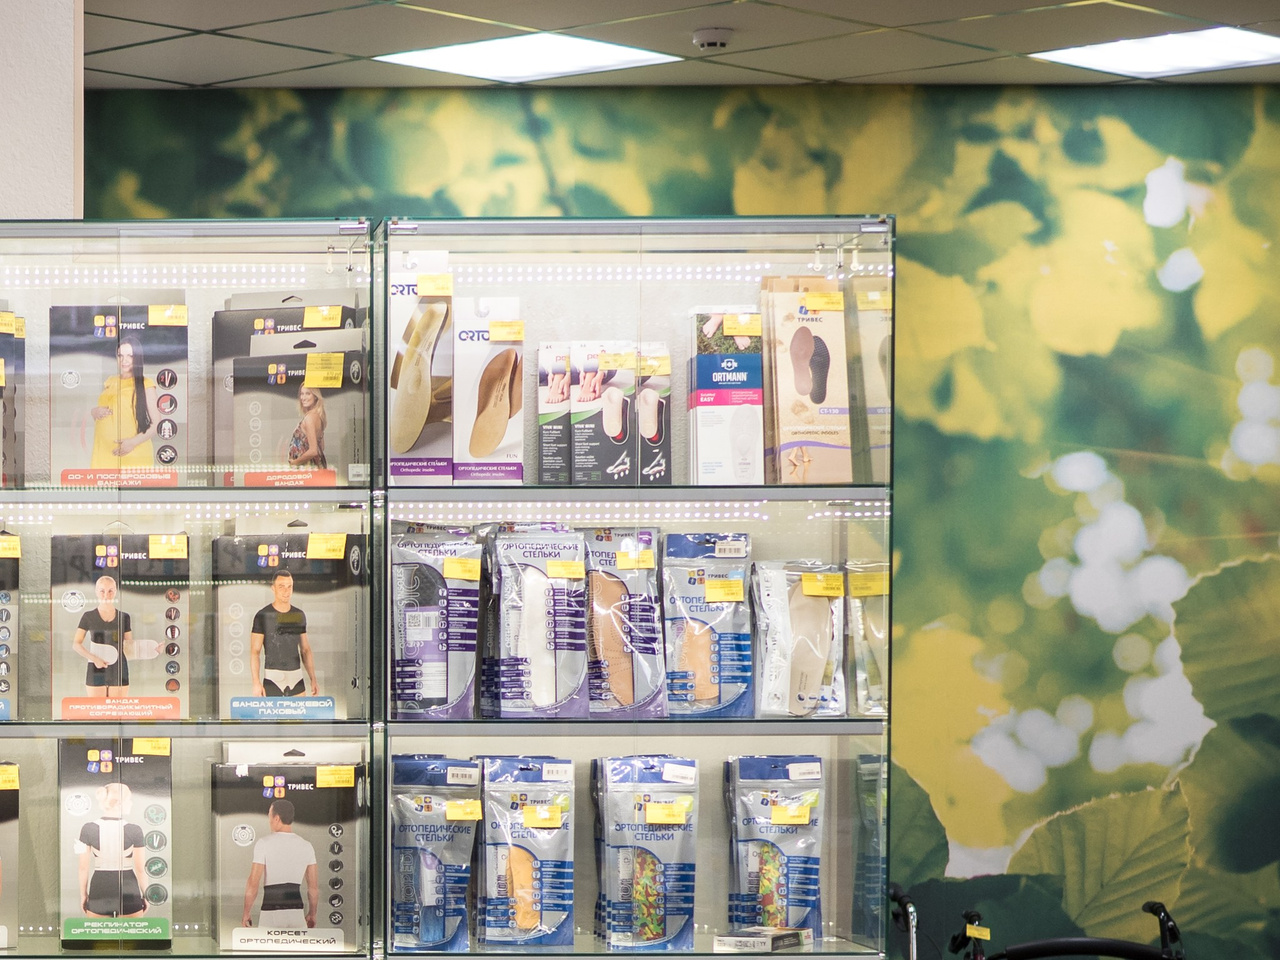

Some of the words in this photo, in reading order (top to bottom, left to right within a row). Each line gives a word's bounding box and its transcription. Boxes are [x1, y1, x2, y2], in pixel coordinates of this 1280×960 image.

[277, 324, 302, 332] ТРИВЕС
[712, 372, 747, 382] ORTMANN
[266, 473, 313, 481] ДОРОДОВОЙ
[120, 552, 147, 560] ТРИВЕС
[281, 551, 306, 559] ТРИВЕС
[522, 550, 561, 558] СТЕЛЬКИ
[277, 699, 333, 708] ГРЫЖЕВОЙ
[258, 707, 307, 715] ПАХОВЫЙ
[114, 756, 144, 764] ТРИВЕС
[287, 783, 314, 791] ТРИВЕС
[398, 824, 471, 835] ОРТОПЕДИЧЕСКИЕ
[614, 823, 693, 833] ОРТОПЕДИЧЕСКИЕ
[759, 826, 798, 835] СТЕЛЬКИ
[415, 834, 454, 842] СТЕЛЬКИ
[634, 833, 674, 841] СТЕЛЬКИ
